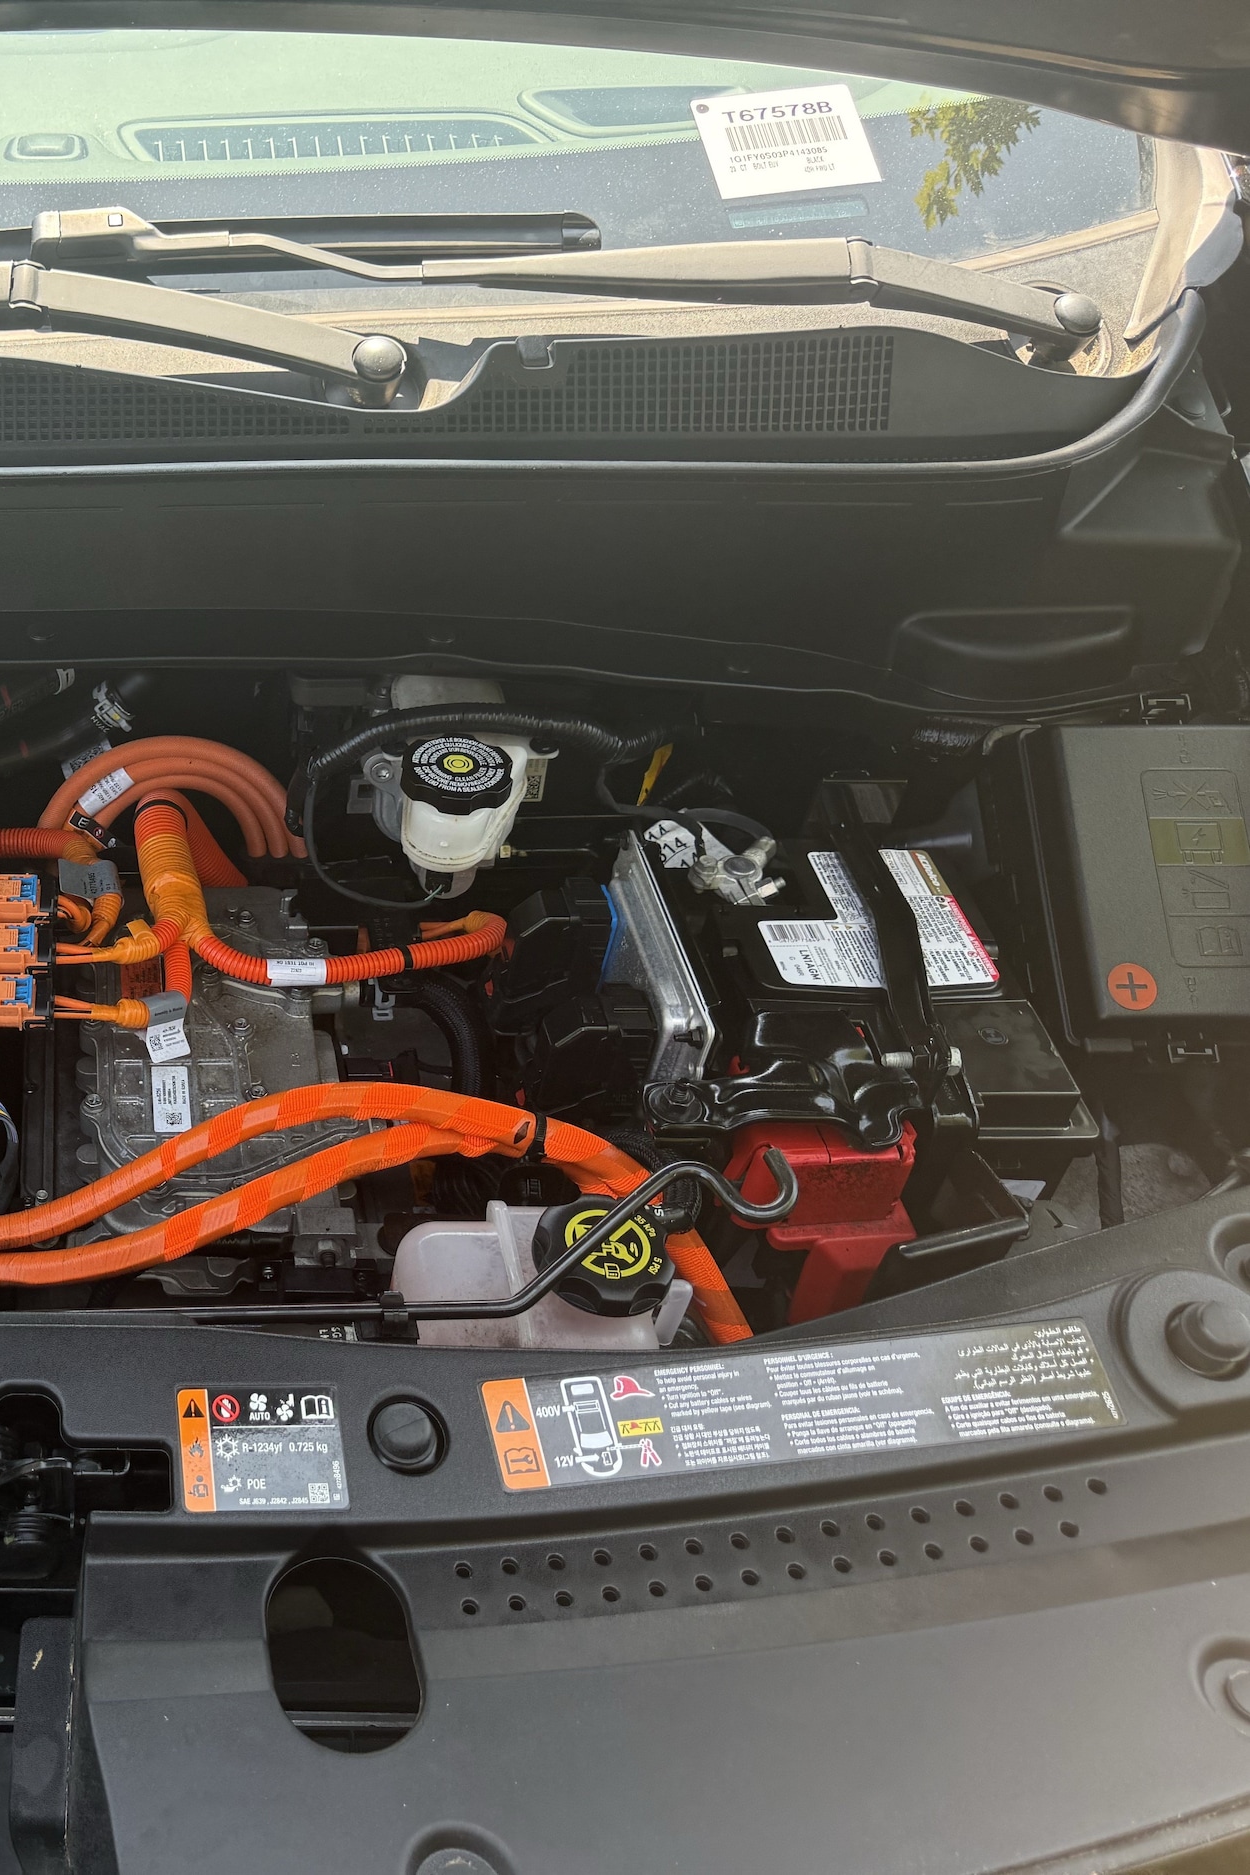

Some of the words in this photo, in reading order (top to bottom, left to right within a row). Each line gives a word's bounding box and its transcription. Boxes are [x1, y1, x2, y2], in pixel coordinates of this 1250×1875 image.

[722, 101, 833, 123] T67578B
[800, 949, 821, 980] LN1AGM
[633, 1214, 645, 1224] 35
[644, 1223, 657, 1238] kPa
[647, 1264, 661, 1275] PSI
[763, 1355, 797, 1365] PERSONNEL
[249, 1412, 270, 1421] AUTO
[536, 1405, 561, 1418] 400V
[781, 1411, 812, 1421] PERSONAL
[242, 1442, 283, 1454] R-1234yf
[289, 1442, 314, 1452] 0.725
[316, 1442, 328, 1454] kg
[554, 1456, 574, 1468] 12V
[247, 1478, 266, 1490] POE
